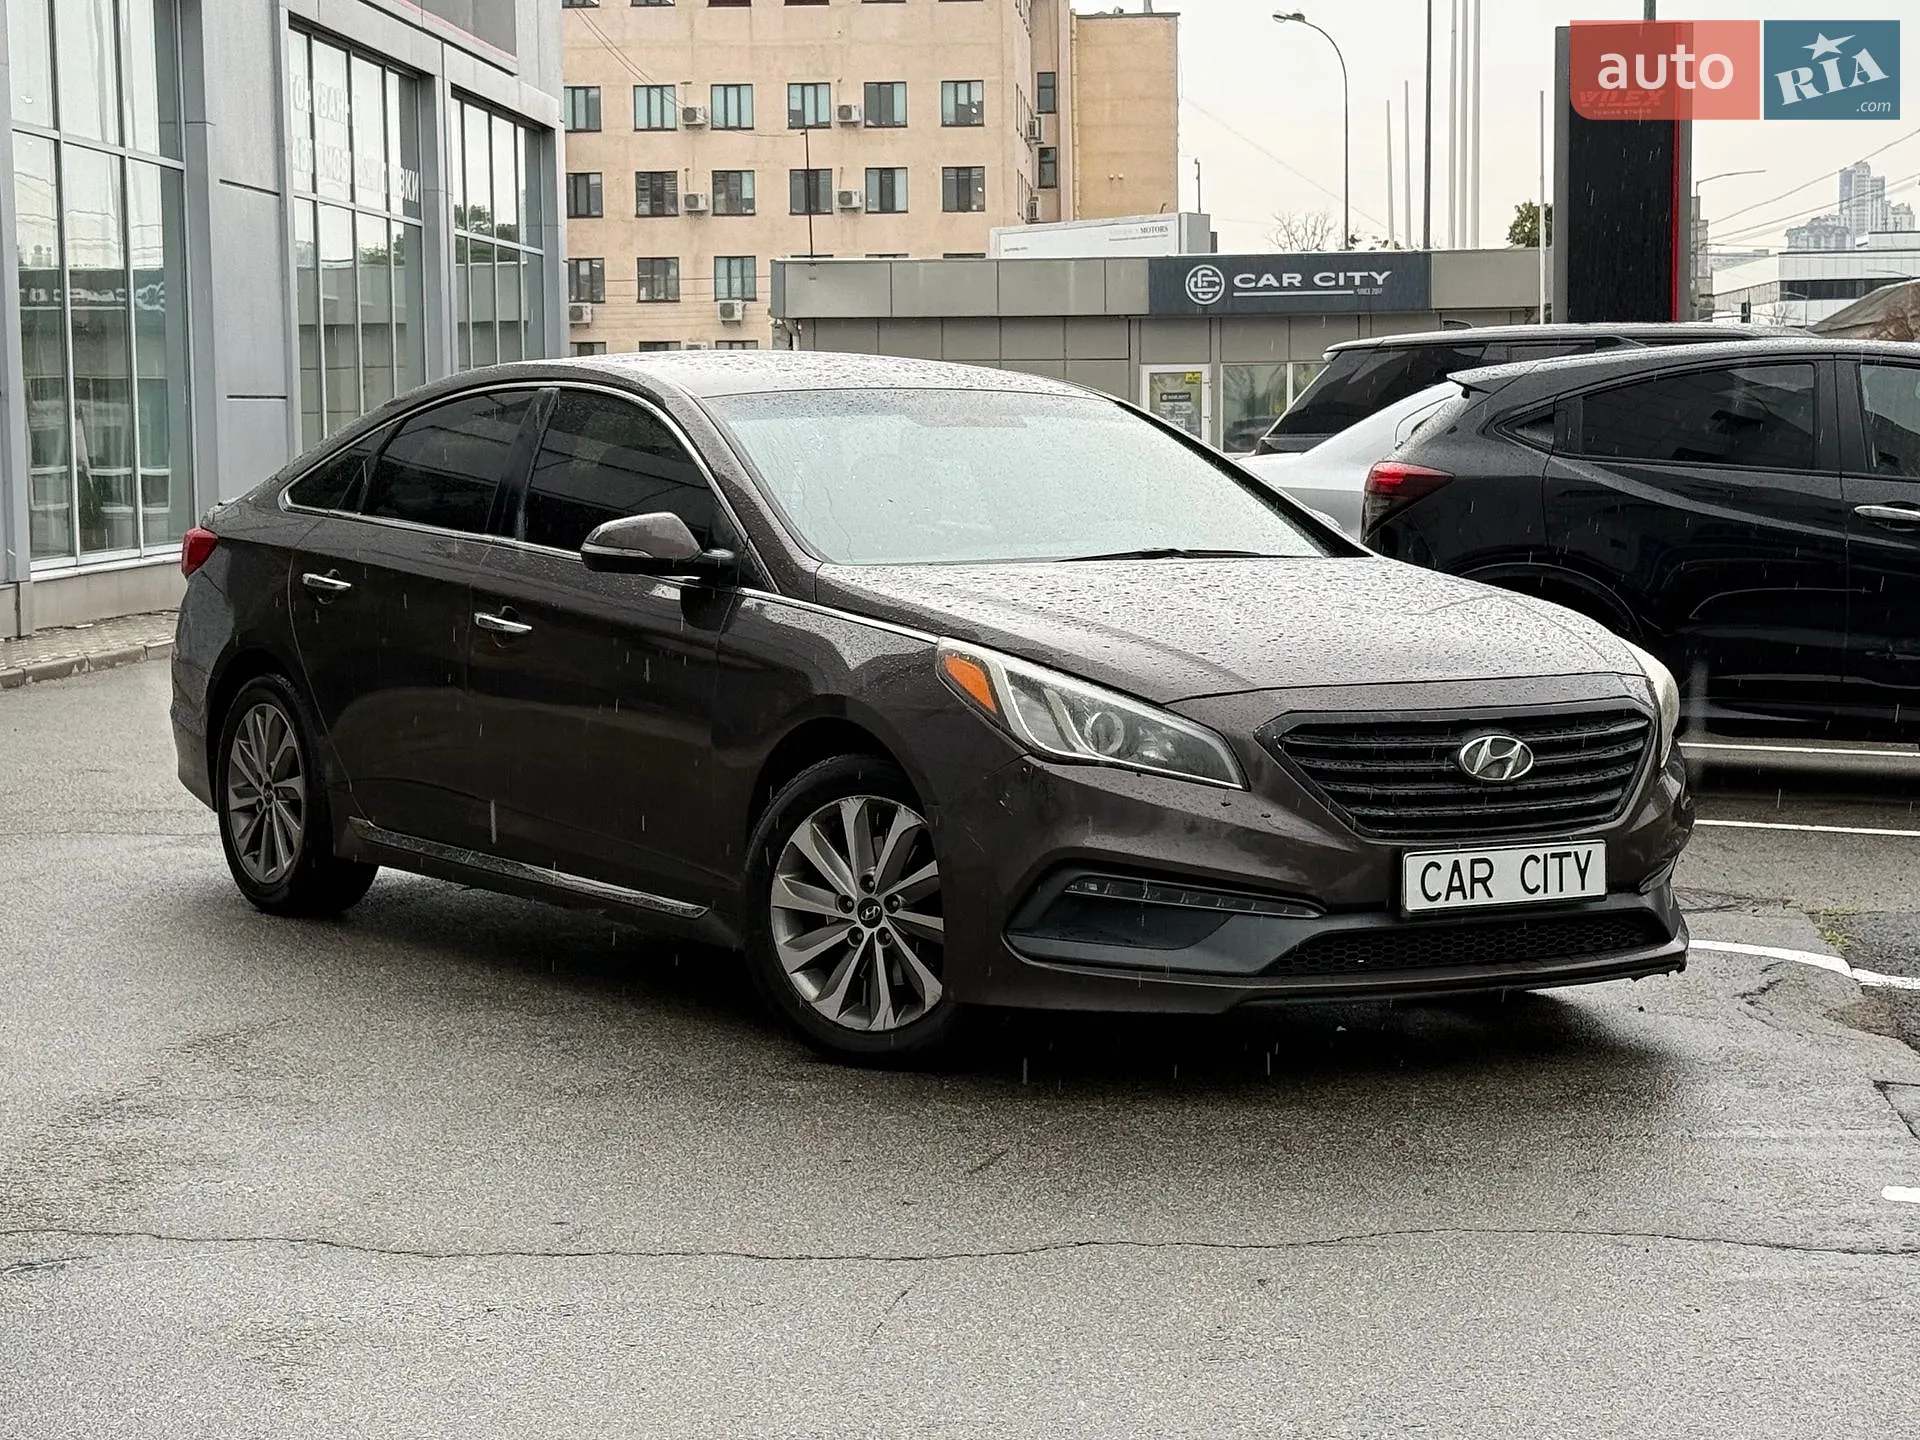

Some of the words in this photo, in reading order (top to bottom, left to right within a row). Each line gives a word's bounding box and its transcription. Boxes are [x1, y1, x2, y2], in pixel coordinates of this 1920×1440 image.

[1579, 89, 1666, 107] VILEX
[1233, 272, 1303, 289] CAR
[1313, 270, 1393, 287] CITY
[1420, 857, 1495, 903] CAR
[1520, 849, 1593, 896] CITY
